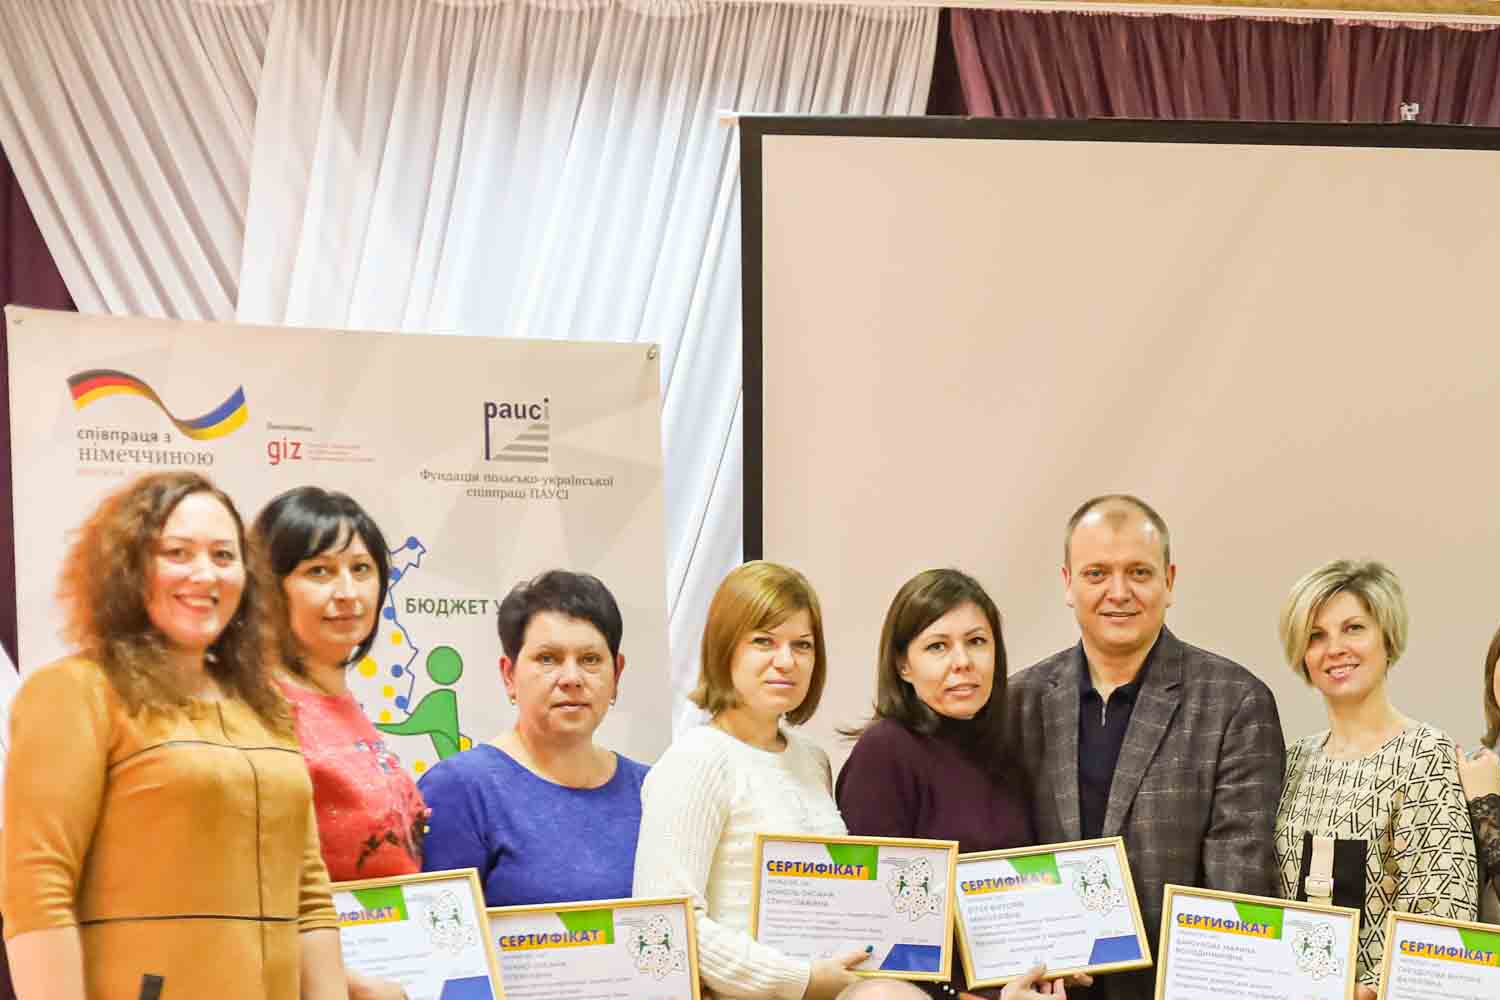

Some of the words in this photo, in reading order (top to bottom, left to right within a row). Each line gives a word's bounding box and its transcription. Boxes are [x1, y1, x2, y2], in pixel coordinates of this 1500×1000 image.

[76, 427, 159, 446] співпраця
[484, 397, 550, 461] pauci
[78, 446, 215, 468] німеччиною
[266, 437, 302, 466] giz
[405, 598, 489, 618] БЮДЖЕТ
[767, 859, 864, 877] СЕРТИФІКАТ
[1176, 912, 1269, 935] СЕРТИФІКАТ
[498, 929, 600, 948] СЕРТИФІКАТ
[1399, 939, 1493, 963] СЕРТИФІКАТ
